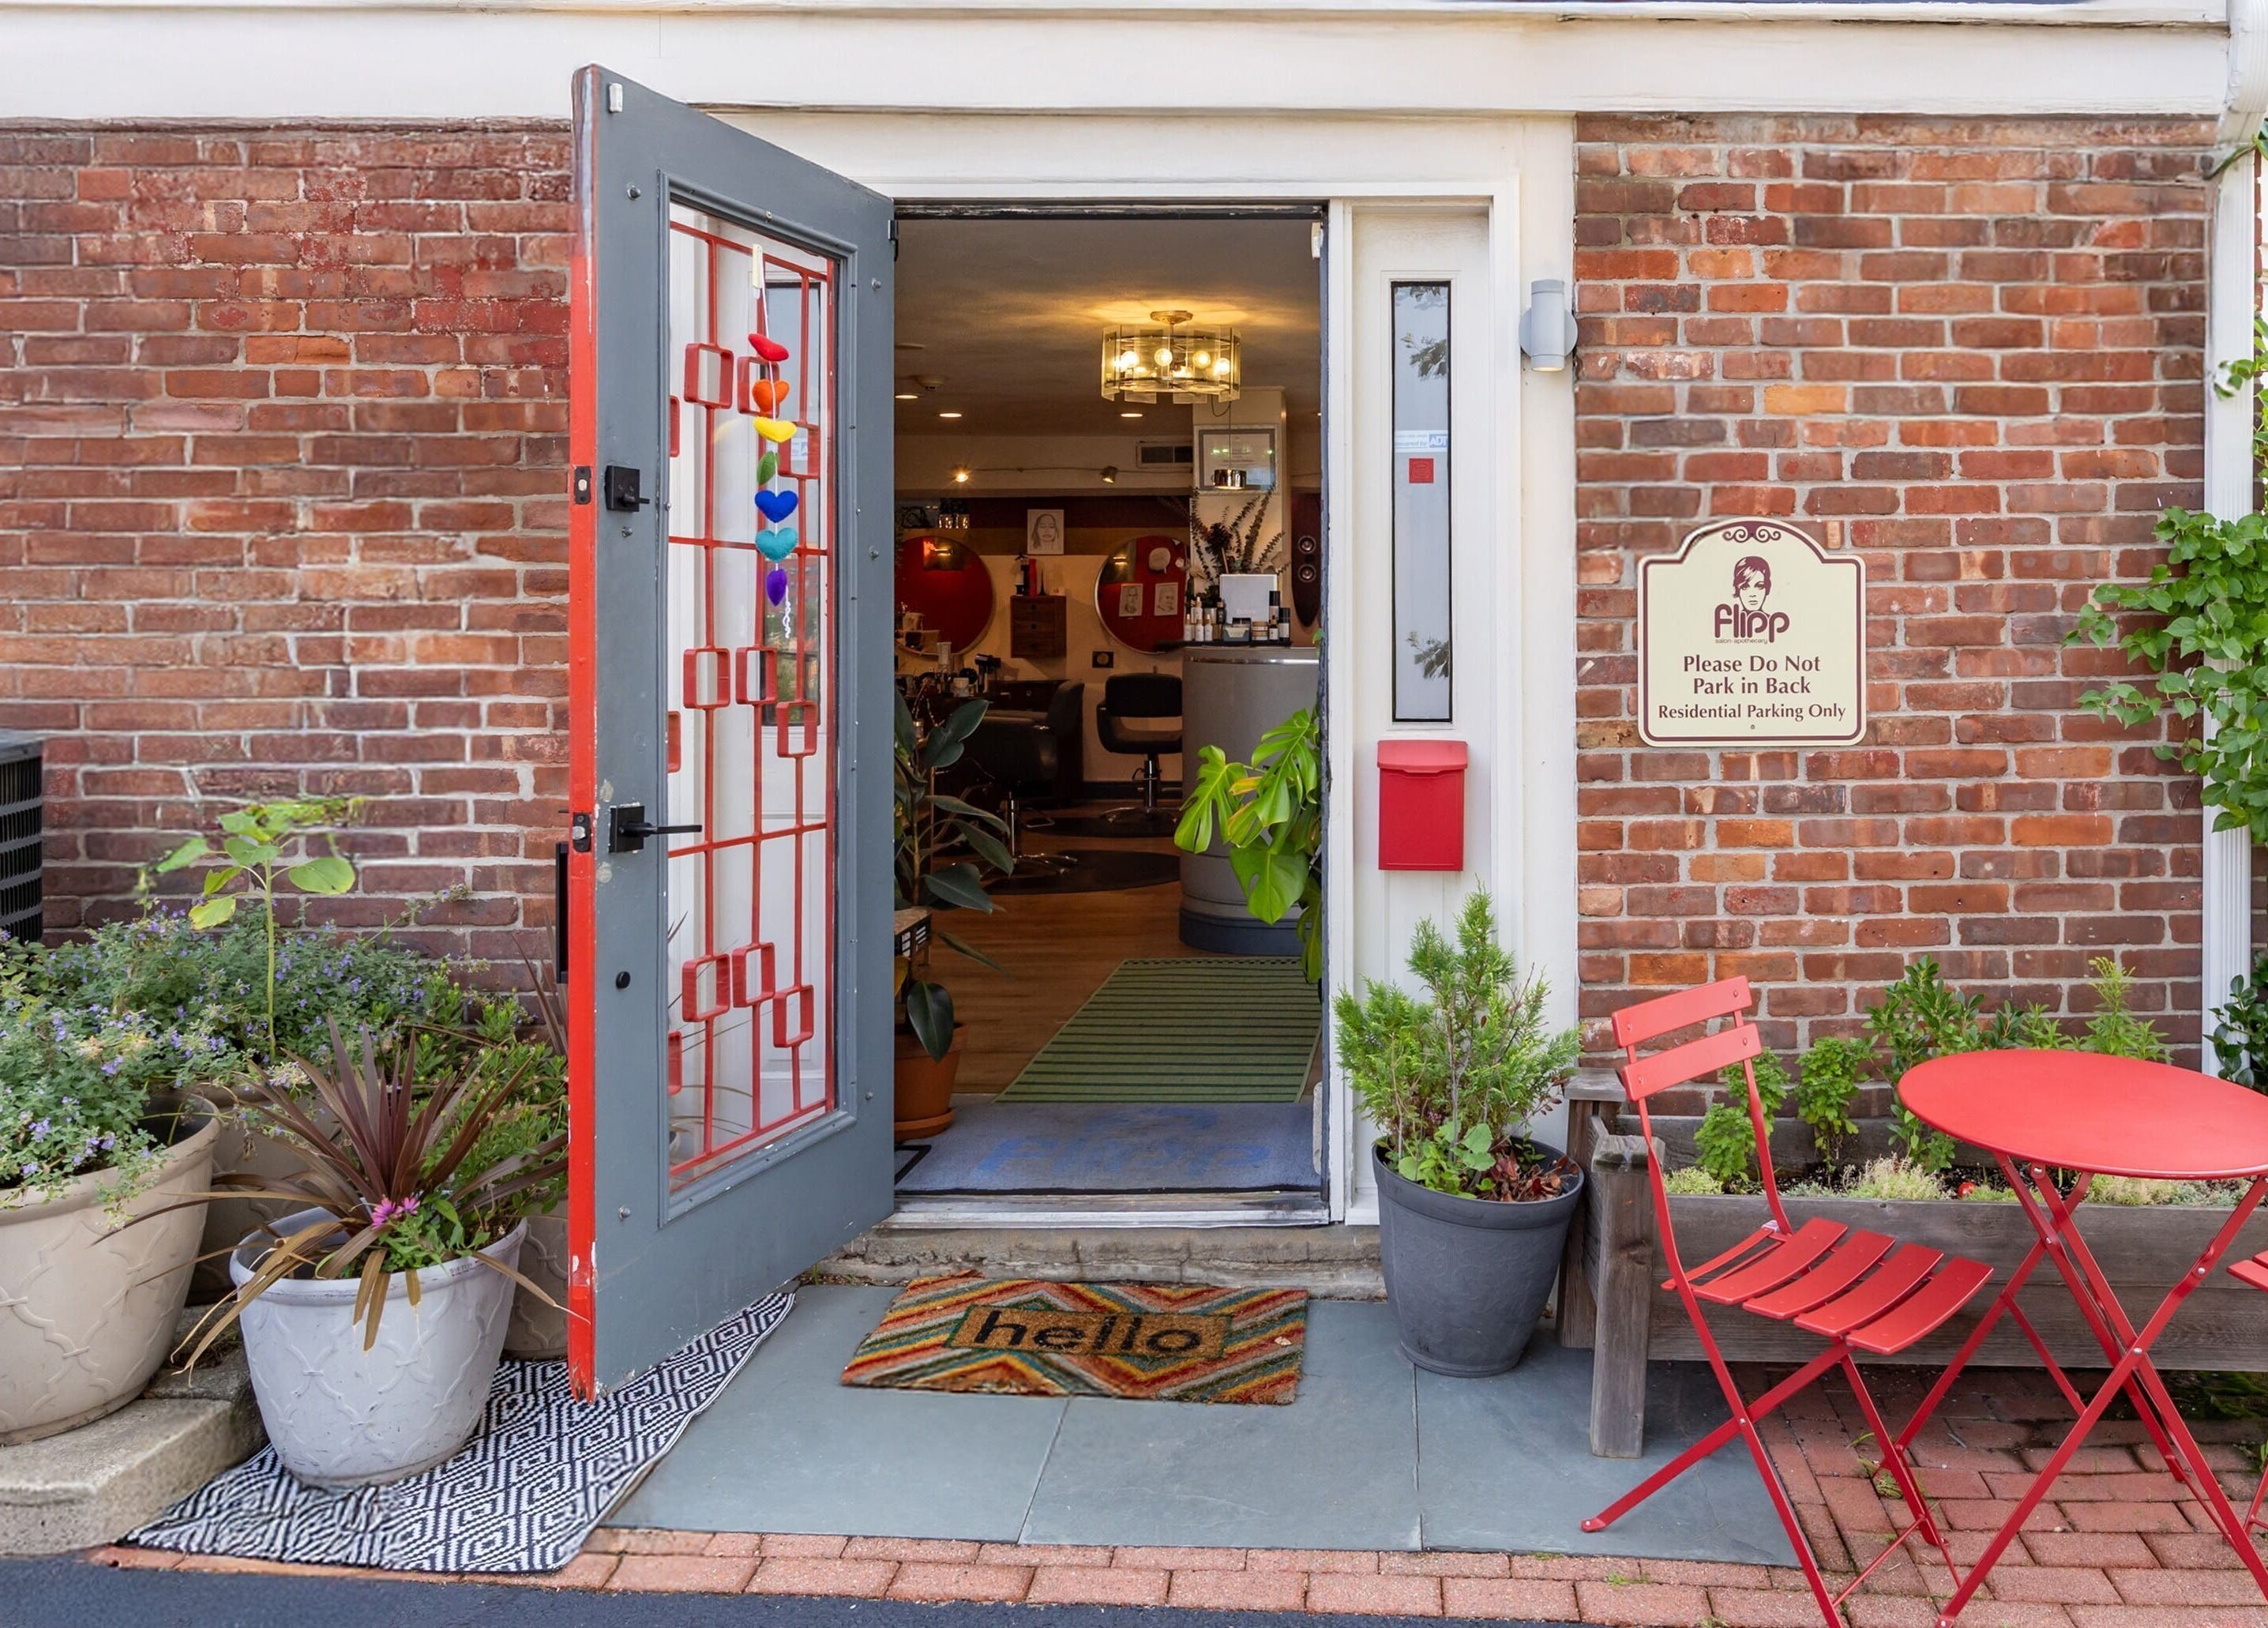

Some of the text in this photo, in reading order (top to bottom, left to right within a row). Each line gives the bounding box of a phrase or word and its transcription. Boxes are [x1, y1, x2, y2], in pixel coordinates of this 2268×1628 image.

[1684, 654, 1821, 672] Please Do Not
[1694, 675, 1811, 694] Park in Back
[1658, 702, 1846, 722] Residential Parking Only
[972, 1310, 1202, 1353] hello
